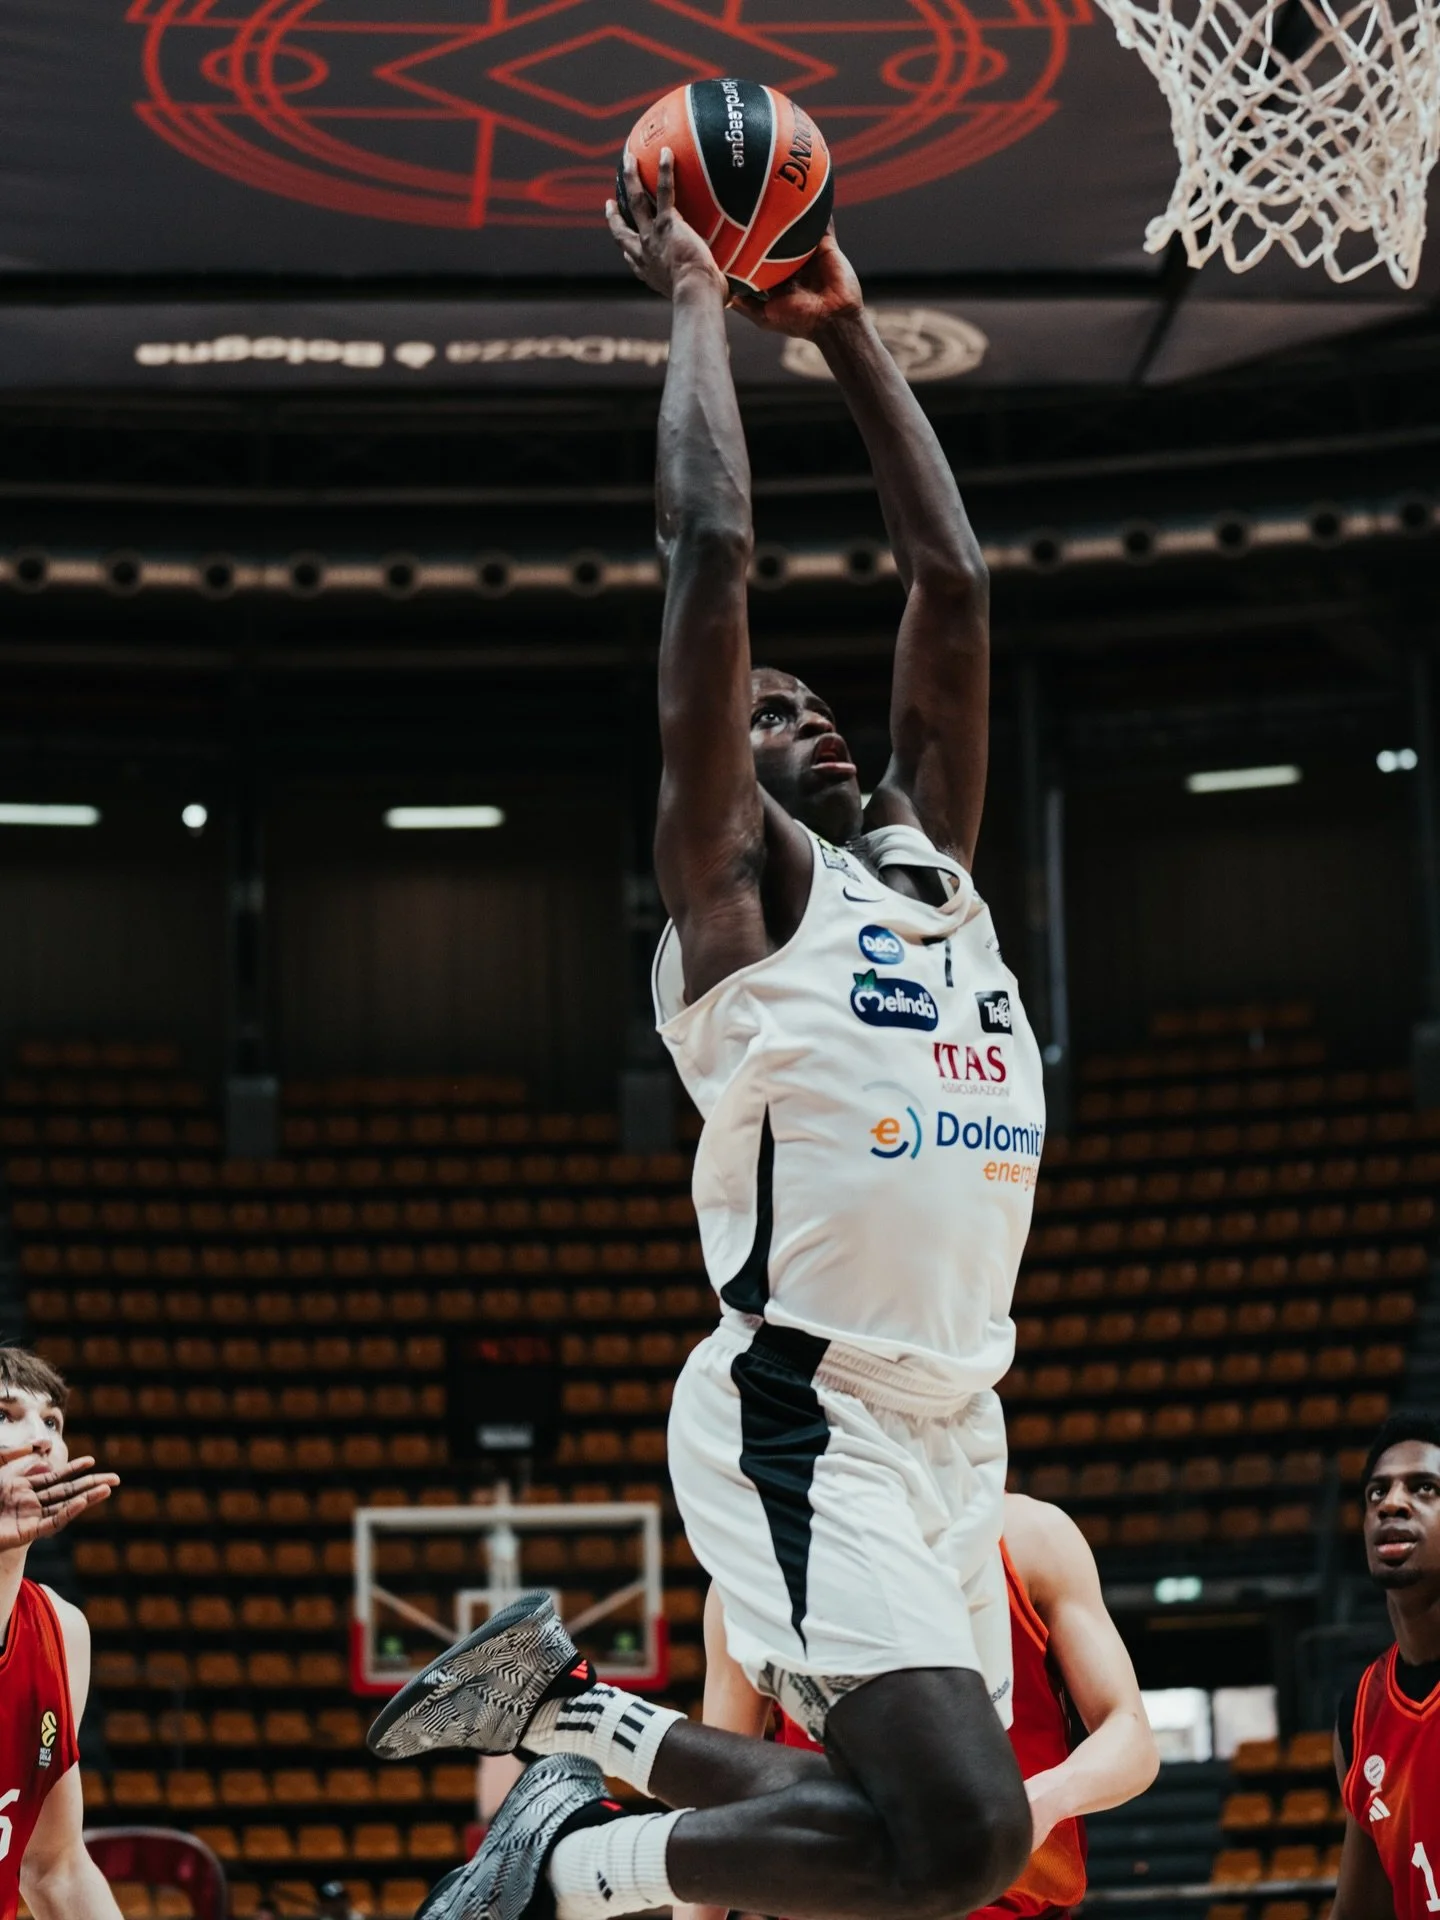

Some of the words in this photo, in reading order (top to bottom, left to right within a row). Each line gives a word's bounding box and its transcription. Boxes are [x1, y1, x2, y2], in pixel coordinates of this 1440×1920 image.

[720, 81, 745, 168] EuroLeague
[854, 988, 936, 1019] Melinda
[932, 1042, 1006, 1083] ITAS
